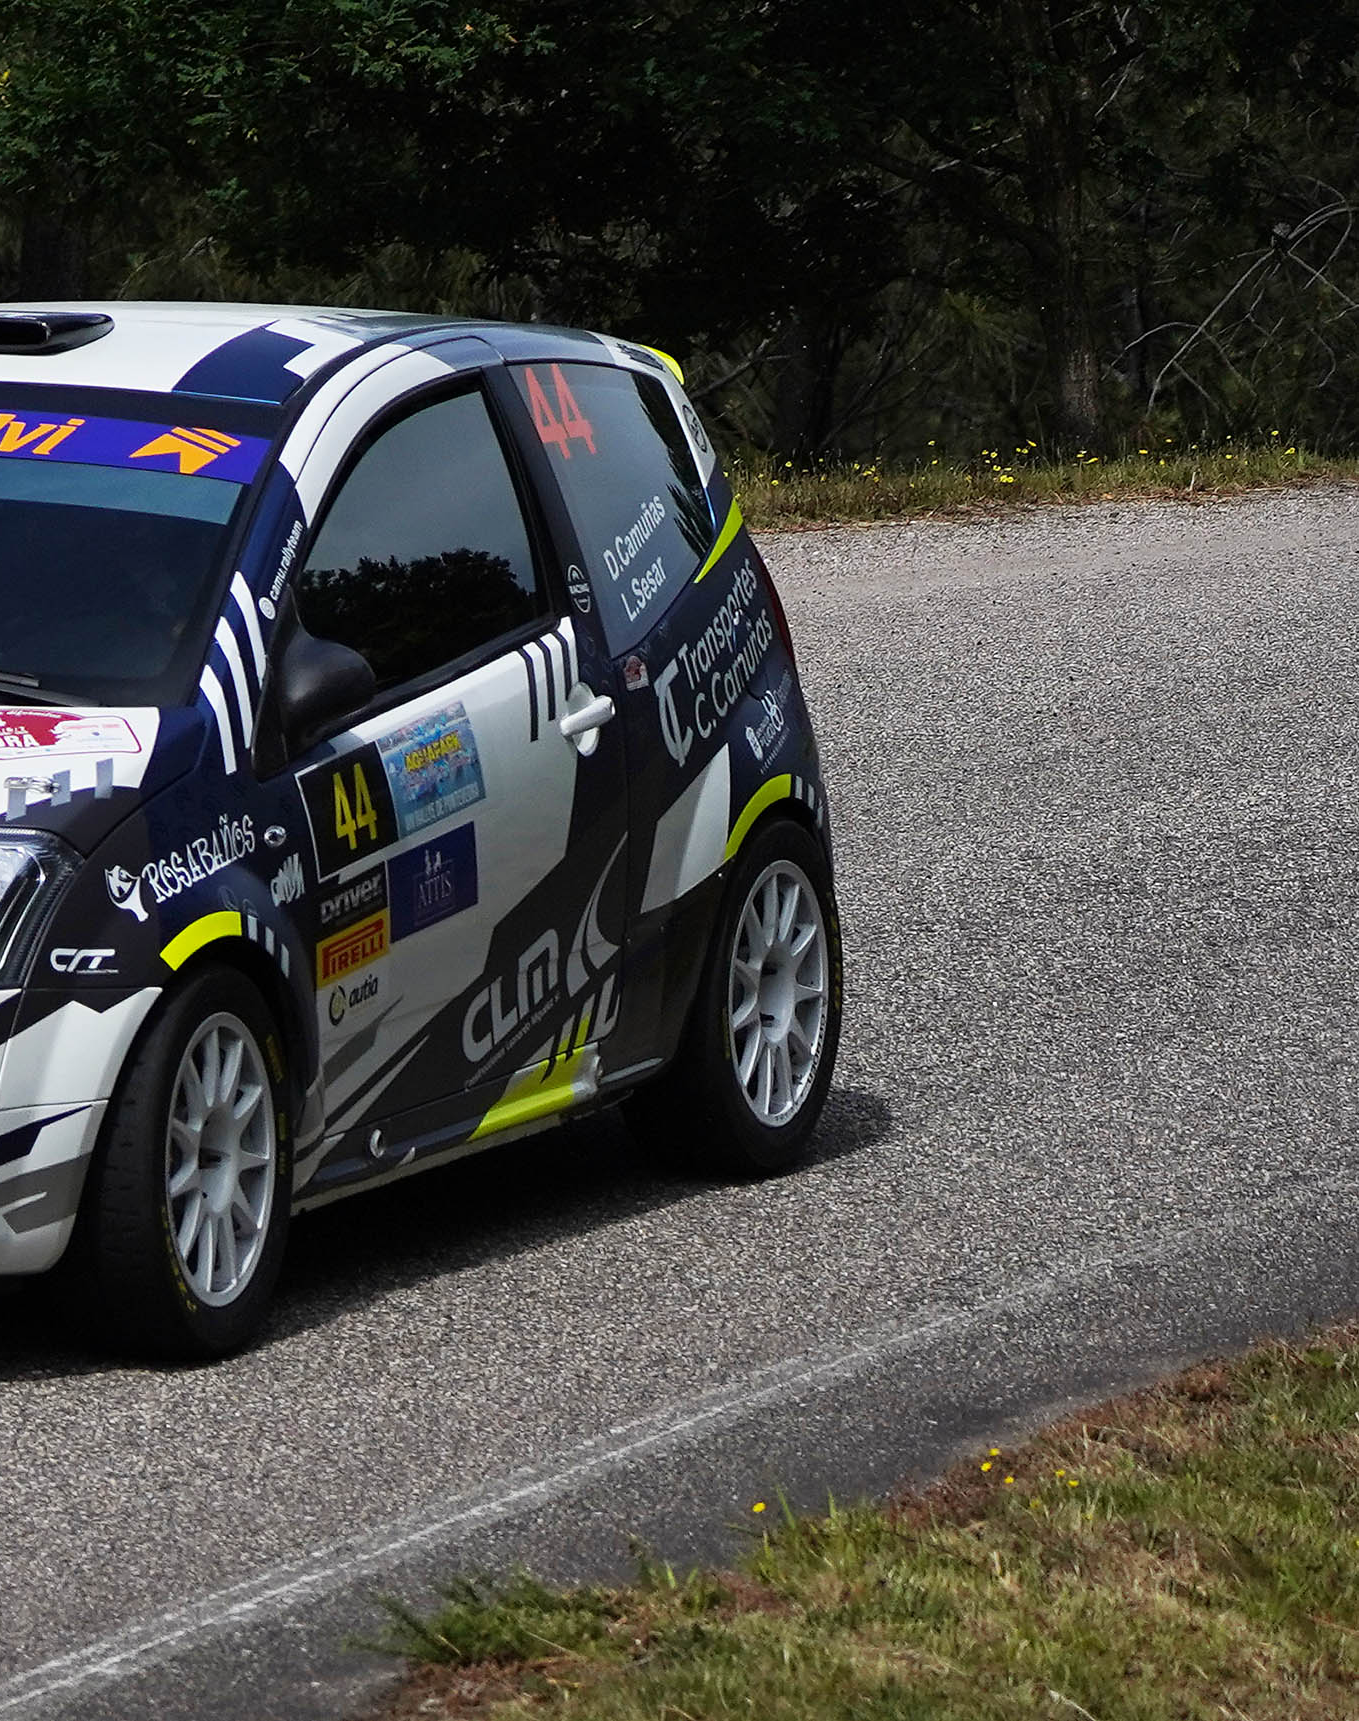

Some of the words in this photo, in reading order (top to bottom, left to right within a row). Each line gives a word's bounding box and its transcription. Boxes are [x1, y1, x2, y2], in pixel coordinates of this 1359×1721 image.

[525, 364, 597, 460] 44
[678, 558, 757, 690] Transportes
[332, 762, 378, 850] 44
[142, 813, 256, 903] ROSABAÑOS
[321, 918, 384, 979] PIRELLI
[462, 928, 560, 1062] CLM
